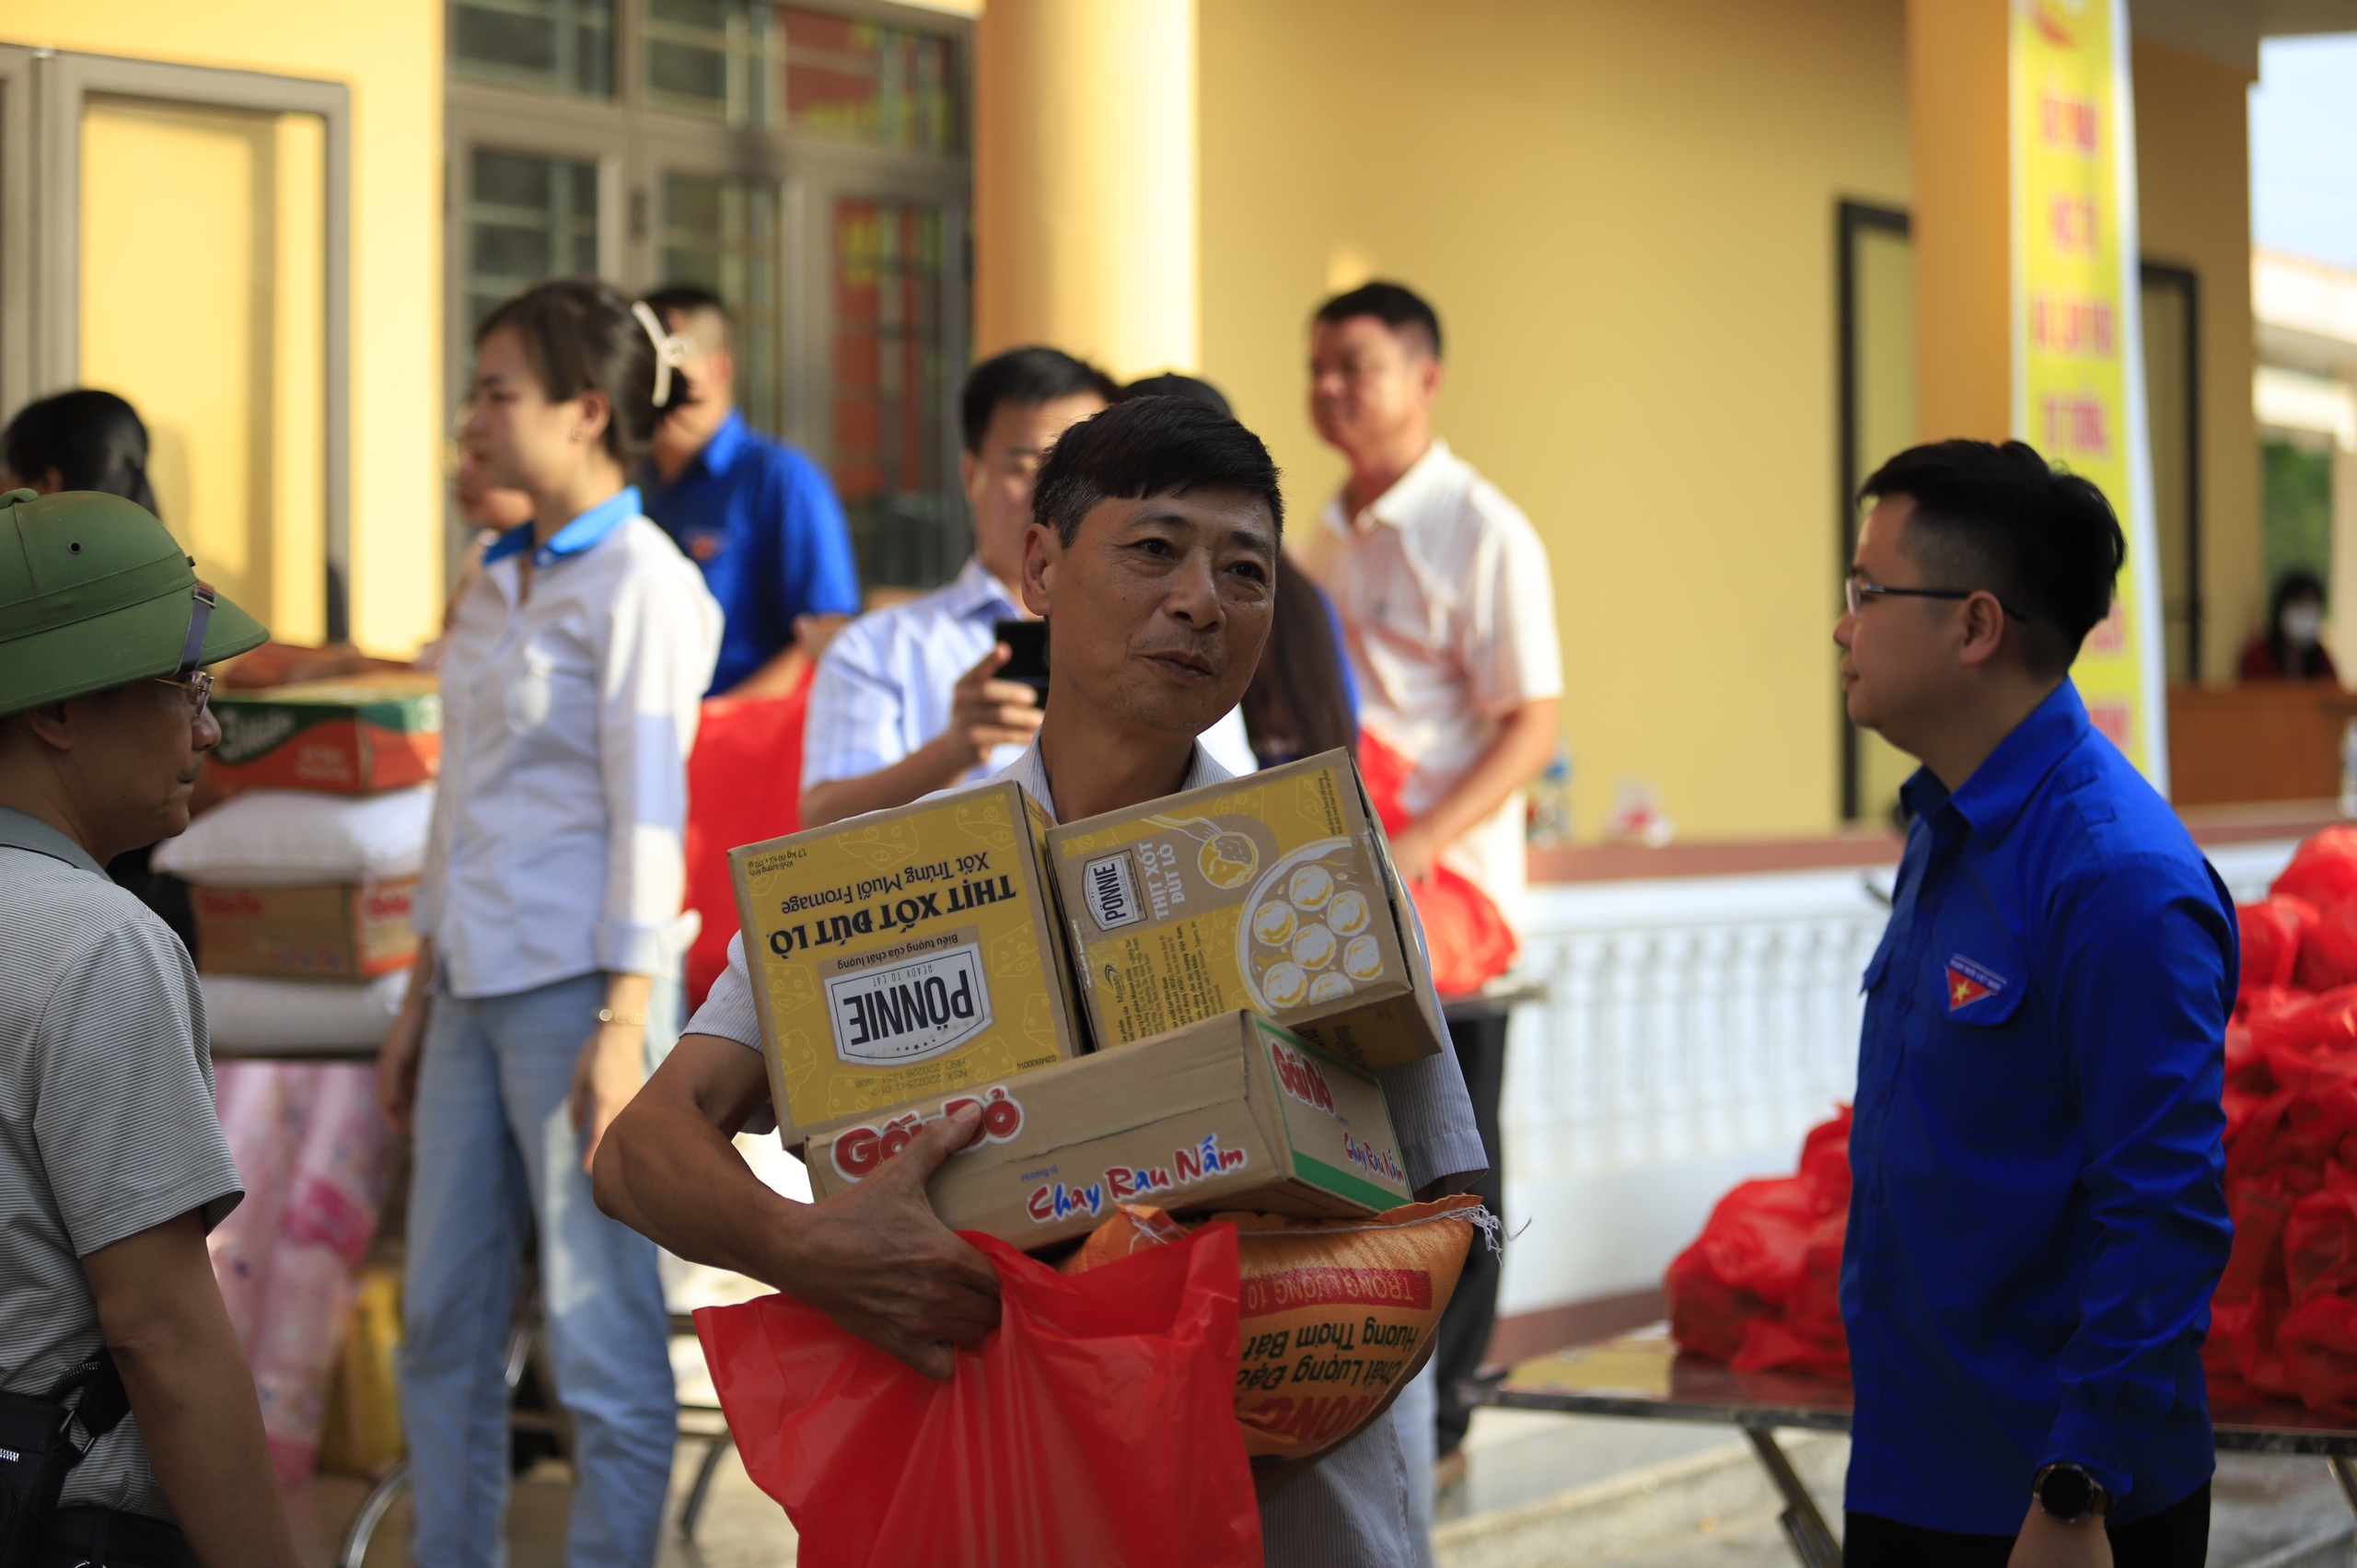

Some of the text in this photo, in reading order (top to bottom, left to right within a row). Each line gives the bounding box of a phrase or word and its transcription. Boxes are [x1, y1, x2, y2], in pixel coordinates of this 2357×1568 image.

[779, 860, 794, 871] Khối
[785, 848, 797, 860] kg
[761, 864, 779, 873] lượng
[1155, 843, 1186, 904] ĐÚT LÒ
[781, 852, 991, 914] Xốt Trứng Muối Fromage
[1093, 863, 1127, 922] PÖNNIE
[1136, 842, 1170, 921] THỊT XỐT
[769, 875, 1016, 959] THỊT XỐT ĐÚT LÒ
[835, 934, 958, 972] Biểu tượng của chất lượng
[872, 963, 933, 987] READY TO EAT
[1112, 975, 1124, 1003] Masan
[842, 969, 975, 1046] PÖNNIE
[1177, 1014, 1187, 1026] gày
[1126, 1031, 1135, 1042] hất
[1137, 1026, 1147, 1038] ông
[905, 1063, 941, 1078] 220226
[945, 1057, 966, 1070] HSD
[1016, 1054, 1057, 1070] 02MB00014
[946, 1069, 968, 1081] NSX
[871, 1084, 891, 1097] 01-2
[832, 1111, 924, 1179] Gấ
[1028, 1133, 1244, 1220] Chay Rau Nấm
[1248, 1284, 1267, 1309] 10
[1242, 1317, 1420, 1361] Hương Thơm Bát
[1237, 1354, 1403, 1391] Chất Lượng Đặc
